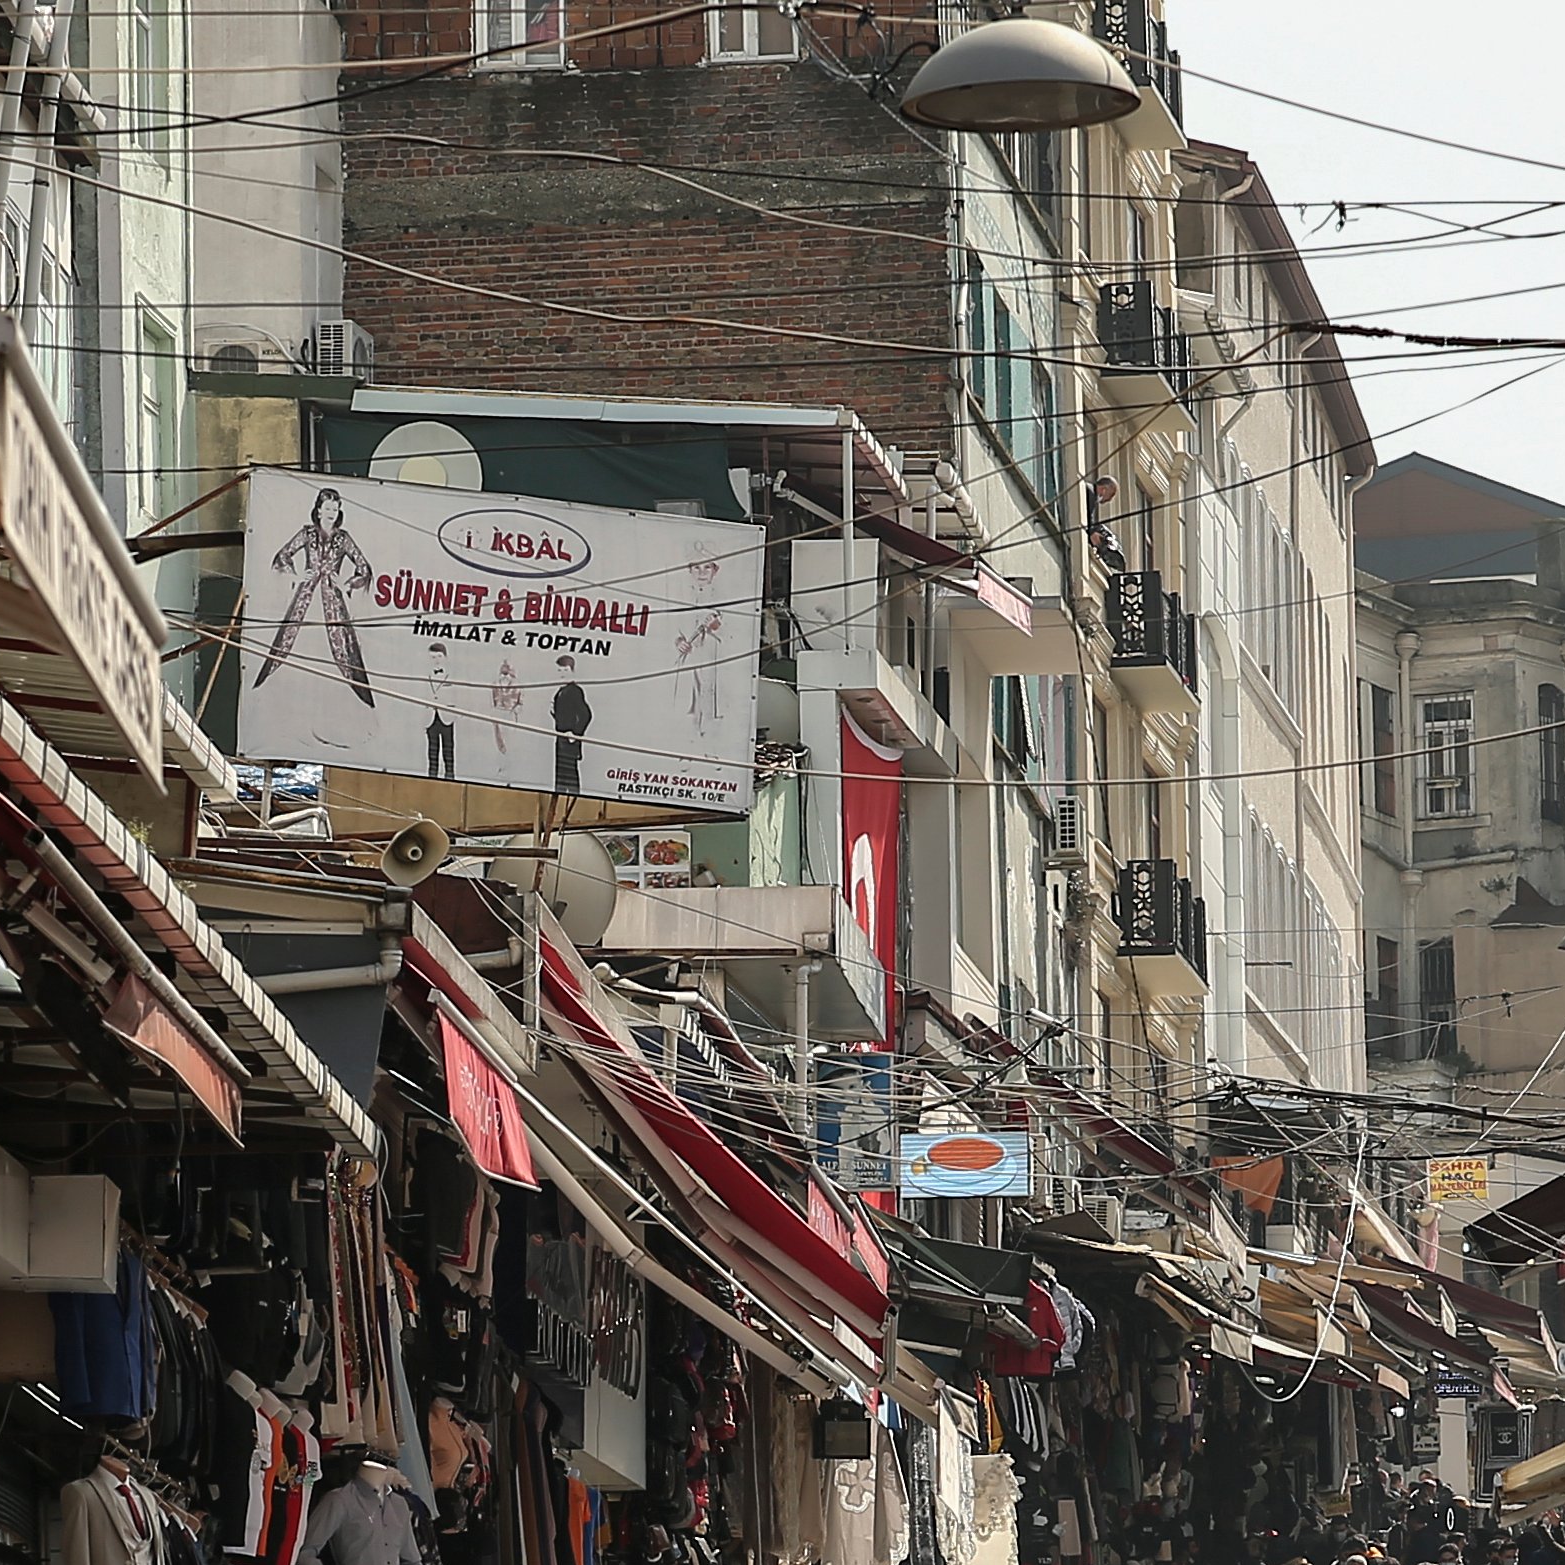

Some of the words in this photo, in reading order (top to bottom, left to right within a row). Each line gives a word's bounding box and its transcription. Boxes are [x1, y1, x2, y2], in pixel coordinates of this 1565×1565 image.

[374, 569, 488, 617] SÜNNET
[494, 588, 514, 621] &
[524, 585, 649, 636] BİNDALLI
[413, 615, 496, 643] İMALAT
[501, 629, 517, 646] &
[525, 631, 612, 656] TOPTAN
[607, 768, 640, 783] GİRİŞ
[644, 773, 669, 785] YAN
[671, 776, 737, 793] SOKAKTAN
[618, 783, 674, 799] RASTIKÇI
[677, 789, 697, 799] SK.
[1430, 1161, 1484, 1172] SAHRA
